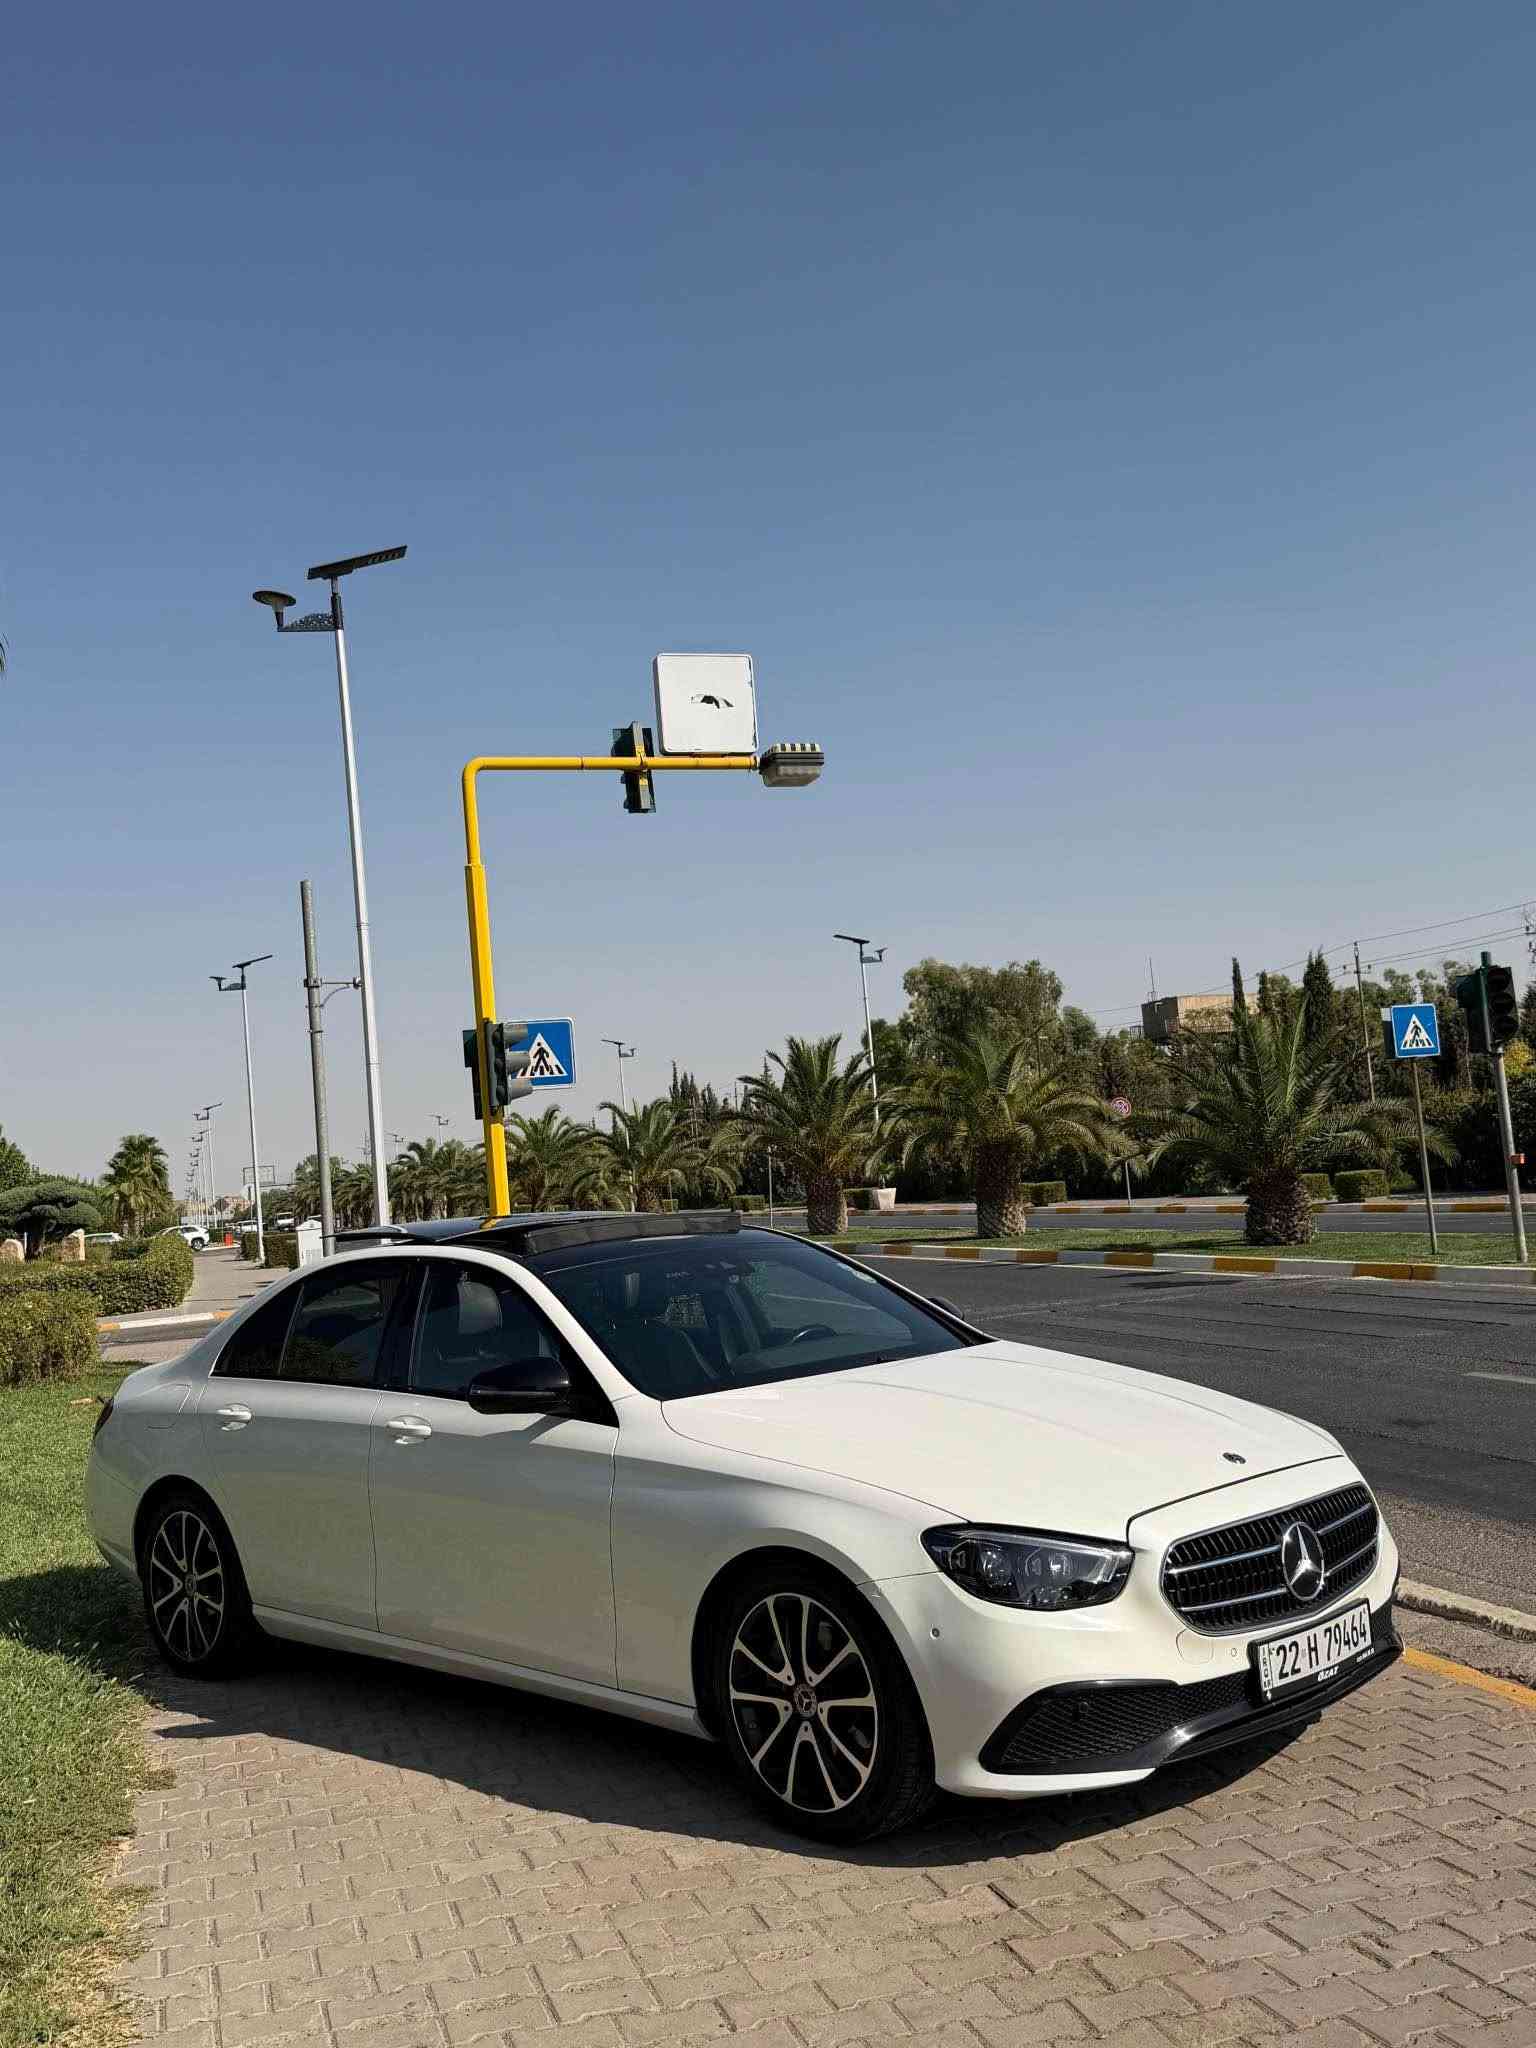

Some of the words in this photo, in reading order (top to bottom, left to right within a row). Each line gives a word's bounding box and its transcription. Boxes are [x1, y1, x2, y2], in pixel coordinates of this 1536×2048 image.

[1276, 1641, 1301, 1680] 22
[1307, 1633, 1320, 1669] H
[1324, 1611, 1367, 1662] 79464
